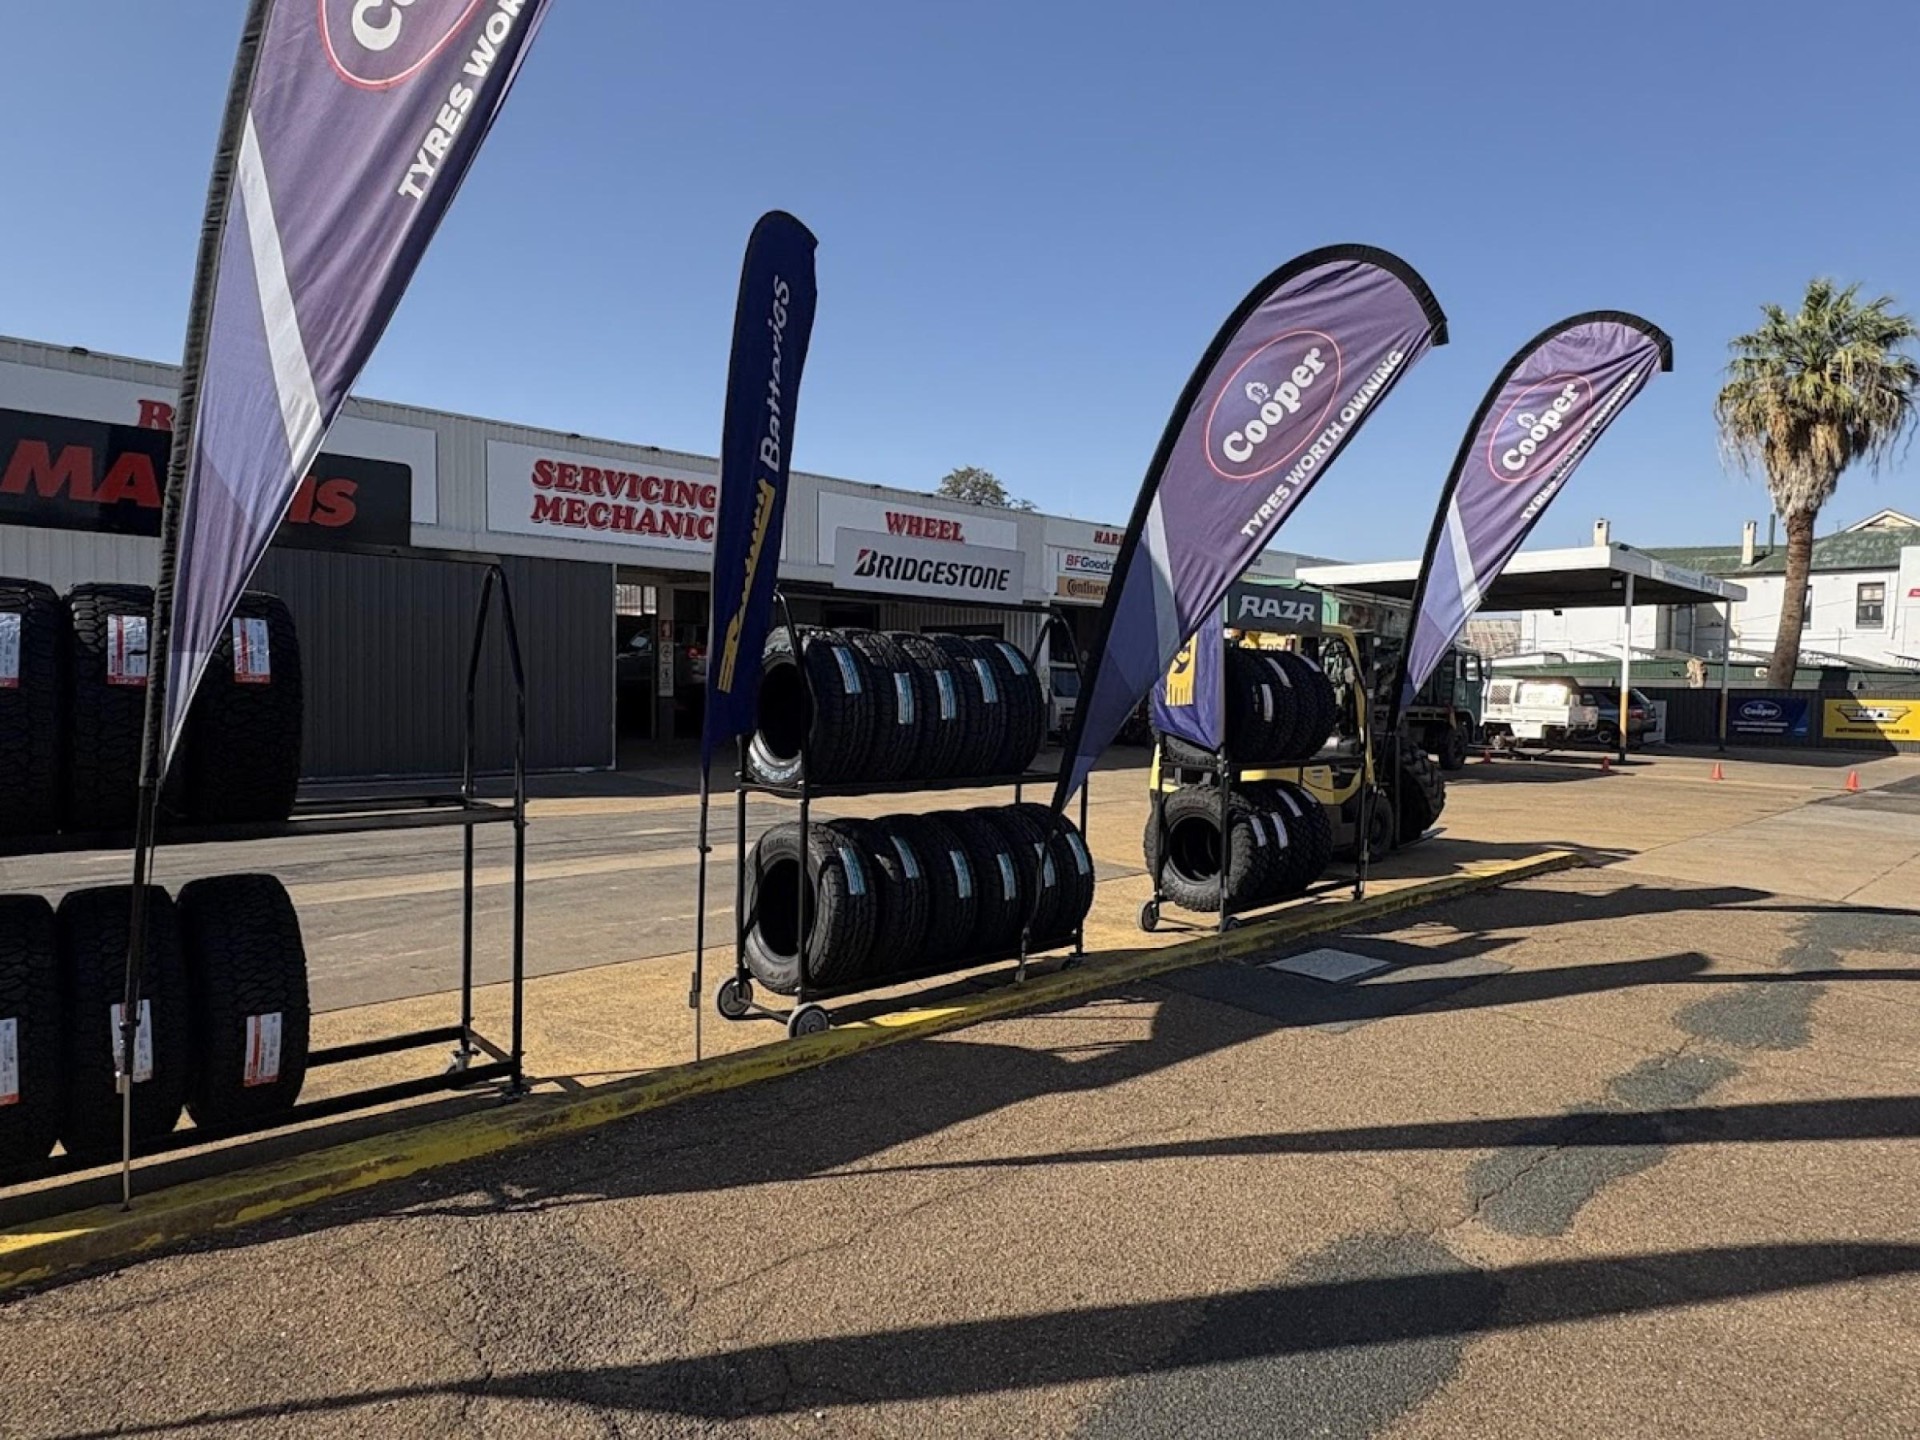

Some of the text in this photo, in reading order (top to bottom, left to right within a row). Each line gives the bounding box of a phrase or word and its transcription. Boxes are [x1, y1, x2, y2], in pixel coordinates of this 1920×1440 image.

[351, 0, 416, 51] C
[398, 82, 475, 201] TYRES
[759, 274, 790, 473] Batteries
[1222, 348, 1326, 463] Cooper
[1502, 383, 1581, 471] Cooper
[1241, 349, 1404, 538] TYRES WORTH OWNING
[1, 439, 358, 528] MAIS
[532, 458, 717, 512] SERVICING
[530, 494, 715, 542] MECHANIC
[885, 512, 965, 543] WHEEL
[853, 548, 1010, 591] BRIDGESTONE
[1065, 553, 1113, 571] BFGoodr
[1066, 578, 1107, 597] Continen
[1237, 594, 1315, 624] RAZR
[1743, 706, 1778, 717] Cooper
